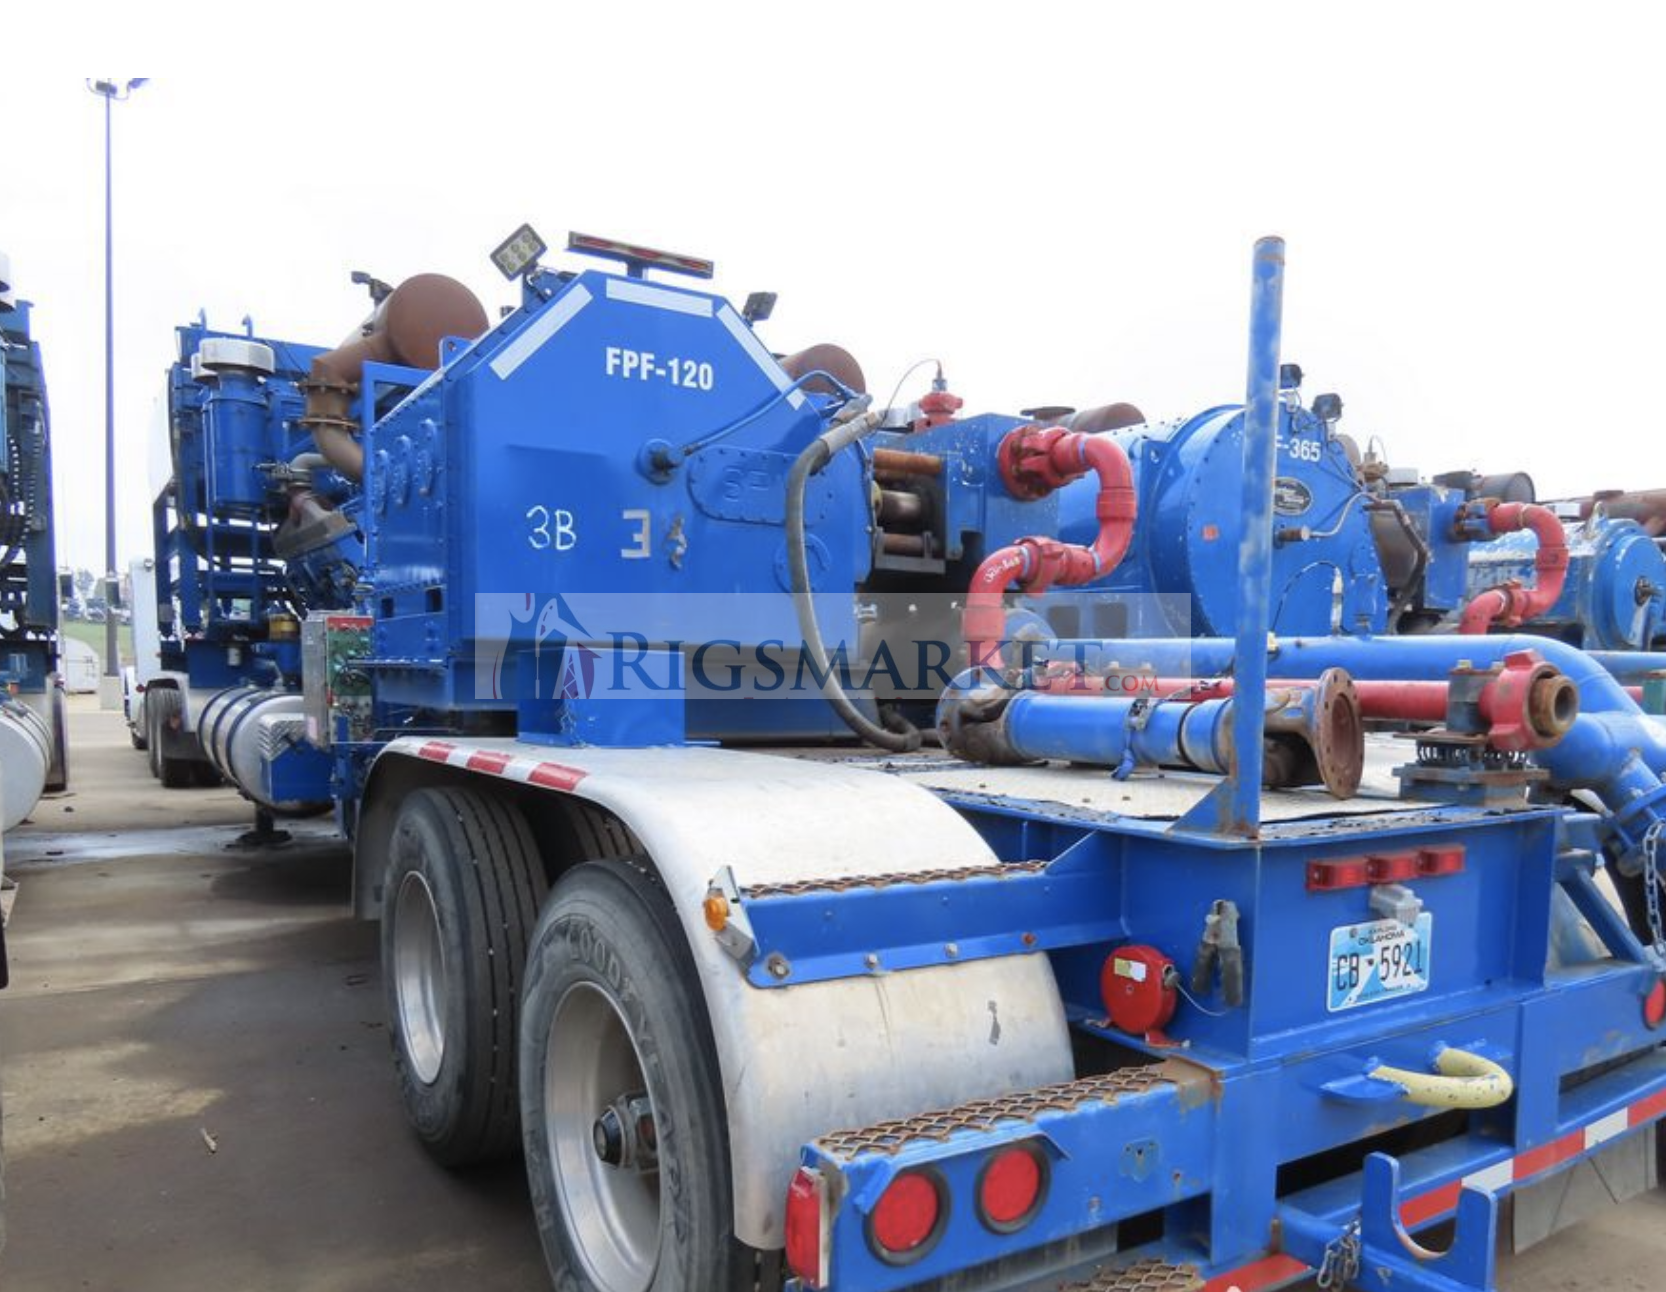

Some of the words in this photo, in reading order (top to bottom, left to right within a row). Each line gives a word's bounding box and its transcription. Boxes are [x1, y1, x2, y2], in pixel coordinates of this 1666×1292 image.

[605, 346, 714, 391] FPF-120
[526, 505, 577, 550] 3B
[1336, 953, 1360, 991] CB
[1379, 939, 1423, 981] 5921
